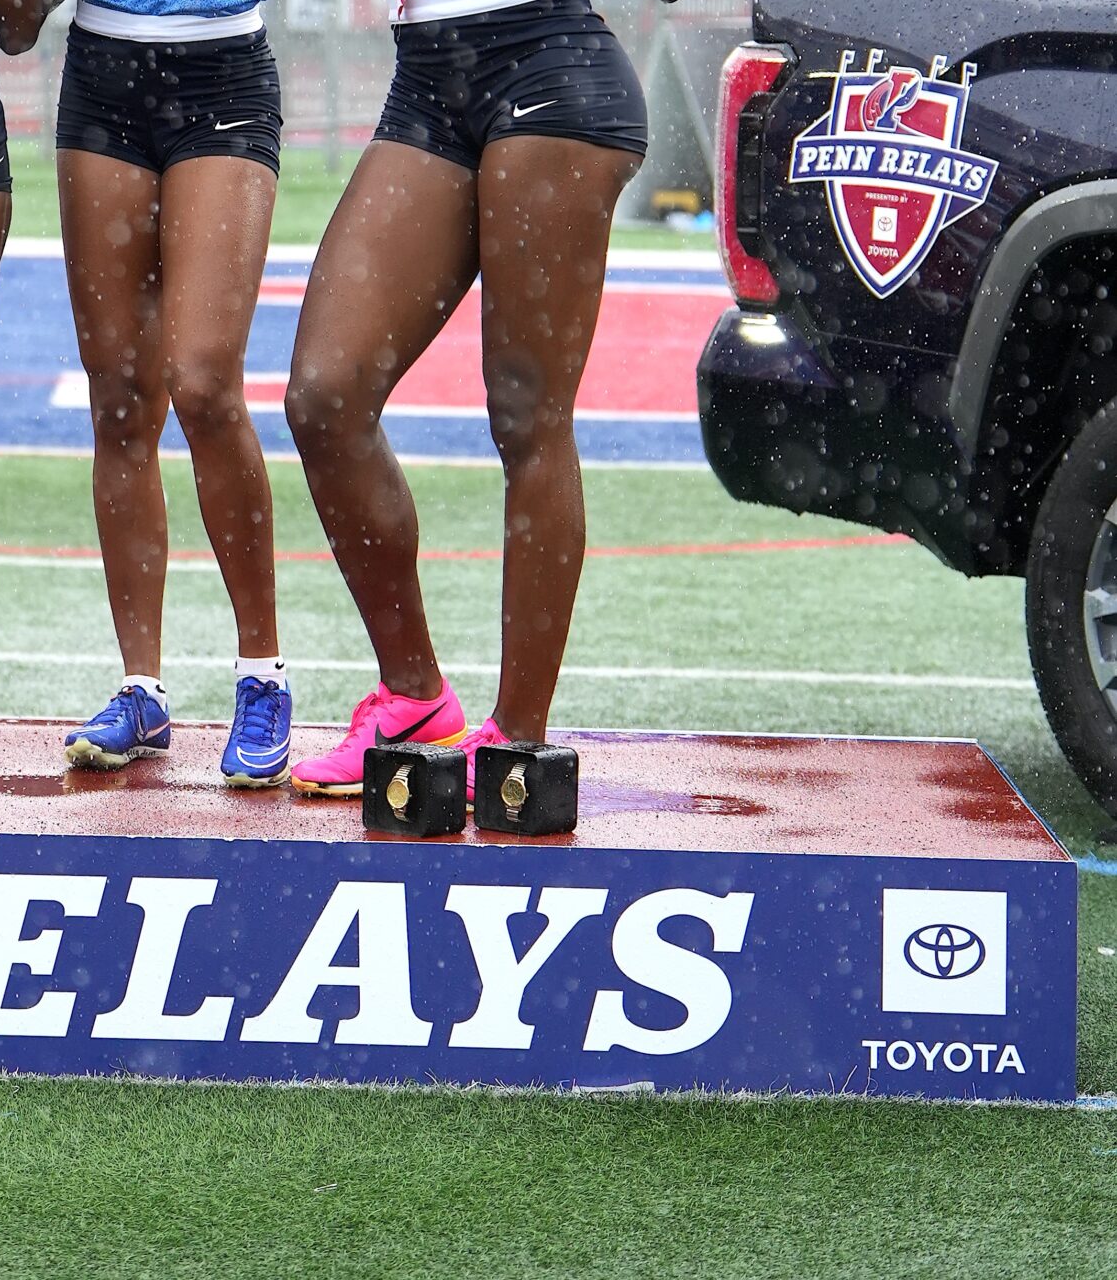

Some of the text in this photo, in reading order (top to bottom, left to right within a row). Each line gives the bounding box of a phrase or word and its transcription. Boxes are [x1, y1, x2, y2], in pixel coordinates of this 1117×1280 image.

[797, 144, 989, 192] PENN RELAYS
[865, 191, 899, 203] PRESENTED
[867, 245, 900, 259] TOYOTA
[861, 1040, 1026, 1074] TOYOTA
